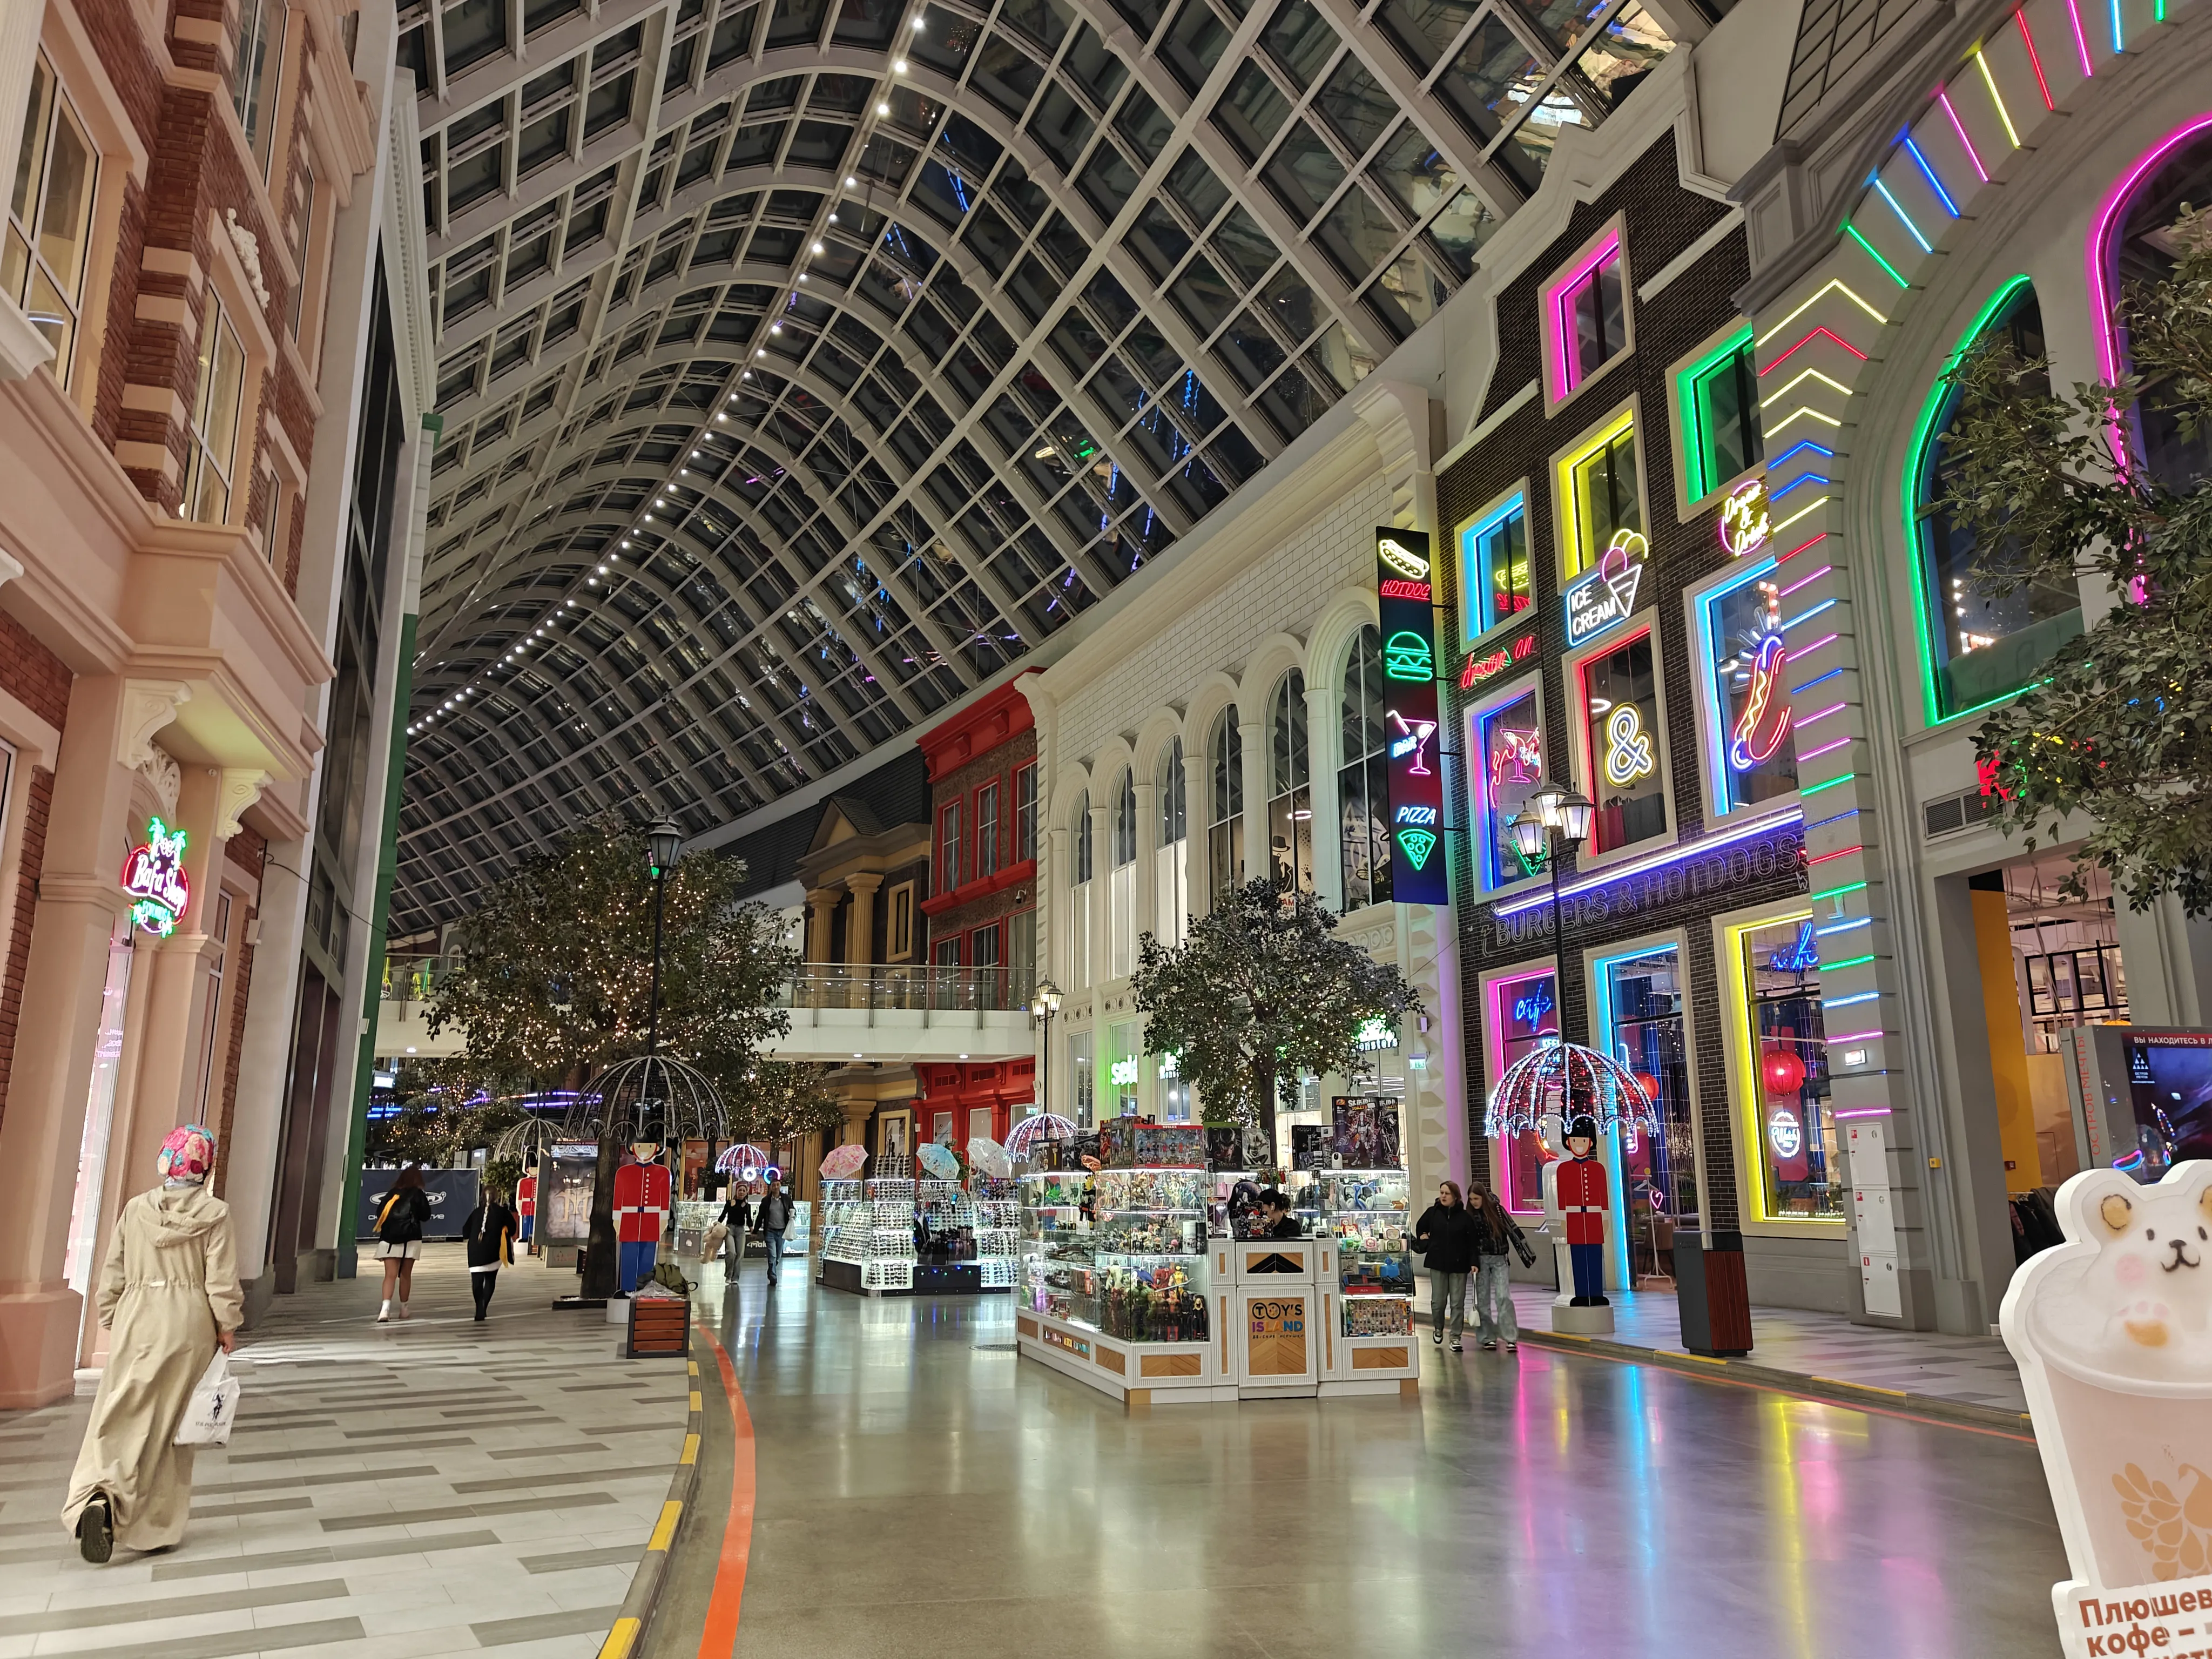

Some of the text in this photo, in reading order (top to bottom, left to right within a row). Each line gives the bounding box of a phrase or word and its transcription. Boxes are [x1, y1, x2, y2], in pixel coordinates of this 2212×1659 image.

[1381, 579, 1431, 598] HOTDOG
[1571, 584, 1593, 612] ICE
[1572, 596, 1616, 636] CREAM
[1515, 636, 1534, 659] on
[1396, 806, 1437, 825] PIZZA
[1496, 833, 1800, 948] BURGERS & HOTDOGS
[2148, 1036, 2198, 1044] НАХОДИТЕСЬ
[2075, 1036, 2101, 1156] ОСТРОВ МЕЧТЫ
[1252, 1302, 1303, 1319] TOY'S
[1252, 1320, 1303, 1332] ISLAND
[2079, 1588, 2212, 1628] Плюшев
[2087, 1622, 2170, 1658] кофе
